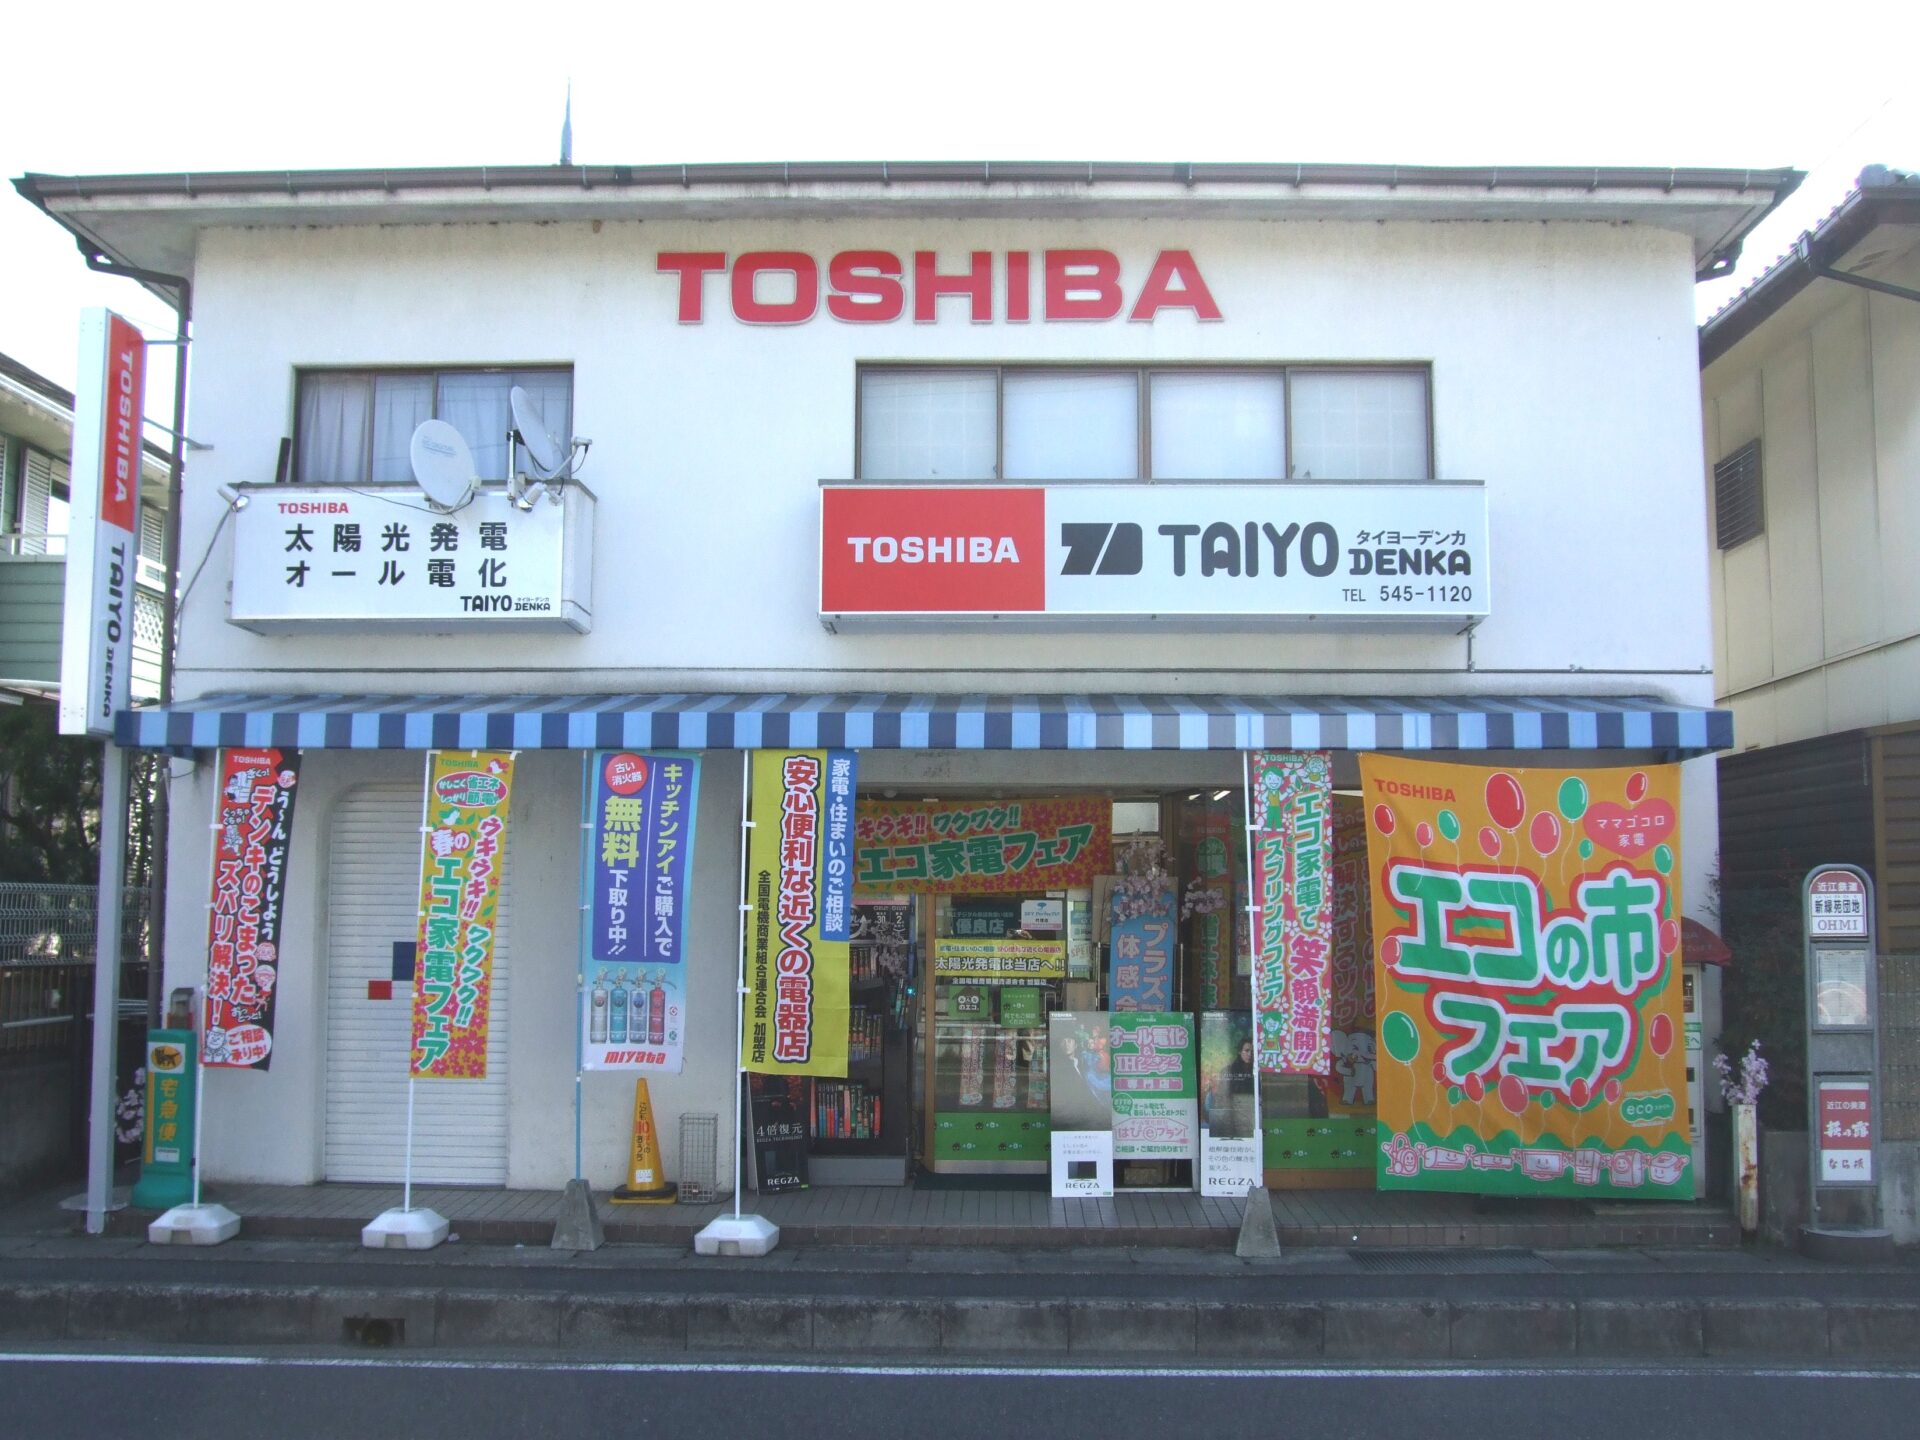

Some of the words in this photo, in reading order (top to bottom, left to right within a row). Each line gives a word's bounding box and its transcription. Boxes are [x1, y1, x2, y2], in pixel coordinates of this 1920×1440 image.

[656, 248, 1223, 326] TOSHIBA
[114, 350, 134, 503] TOSHIBA
[278, 502, 349, 514] TOSHIBA
[285, 522, 509, 554] 太陽光発電
[847, 536, 1020, 564] TOSHIBA
[1158, 520, 1339, 578] TAIYO
[1356, 529, 1466, 546] タイヨーデンカ
[286, 558, 509, 588] オール電化
[1348, 548, 1472, 576] DENKA
[107, 541, 126, 644] TAIYO
[460, 594, 513, 612] TAIYO
[514, 602, 551, 611] DENKA
[1342, 588, 1367, 602] TEL
[1379, 585, 1473, 602] 545-1120
[102, 646, 115, 719] DENKA
[233, 754, 271, 765] TOSHIBA
[441, 759, 479, 768] TOSHIBA
[614, 761, 636, 774] 古い
[1263, 753, 1305, 763] TOSHIBA
[611, 771, 643, 786] 消火器
[1373, 777, 1457, 803] TOSHIBA
[1597, 814, 1665, 829] ママゴコロ
[431, 828, 471, 856] 春の
[825, 757, 851, 933] 家電・住まいのご相談
[858, 822, 1094, 882] エコ家電フェア
[1618, 832, 1646, 848] 家電
[654, 763, 684, 957] キッチンアイご購入で
[1294, 791, 1323, 930] エコ家電で
[231, 785, 277, 1005] デンキのこまった
[261, 846, 285, 941] どうしよう
[776, 757, 817, 1060] 安心便利な近くの電器店
[1261, 836, 1285, 1007] スプリングフェア
[955, 918, 1005, 935] 優良店
[1391, 868, 1658, 994] エコの市
[1817, 919, 1858, 931] OHMI
[208, 858, 242, 1026] ズバリ解決!
[416, 857, 463, 1072] エコ家電フェア
[935, 956, 1065, 972] 太陽光発電は当店へ!!
[751, 1022, 767, 1064] 加盟店
[1110, 1027, 1187, 1046] オール電化
[1434, 993, 1630, 1089] フェア
[603, 1050, 667, 1065] miyata
[158, 1078, 179, 1142] 宅急便
[1626, 1103, 1654, 1116] eco
[767, 1176, 800, 1186] REGZA
[1208, 1177, 1255, 1186] REGZA
